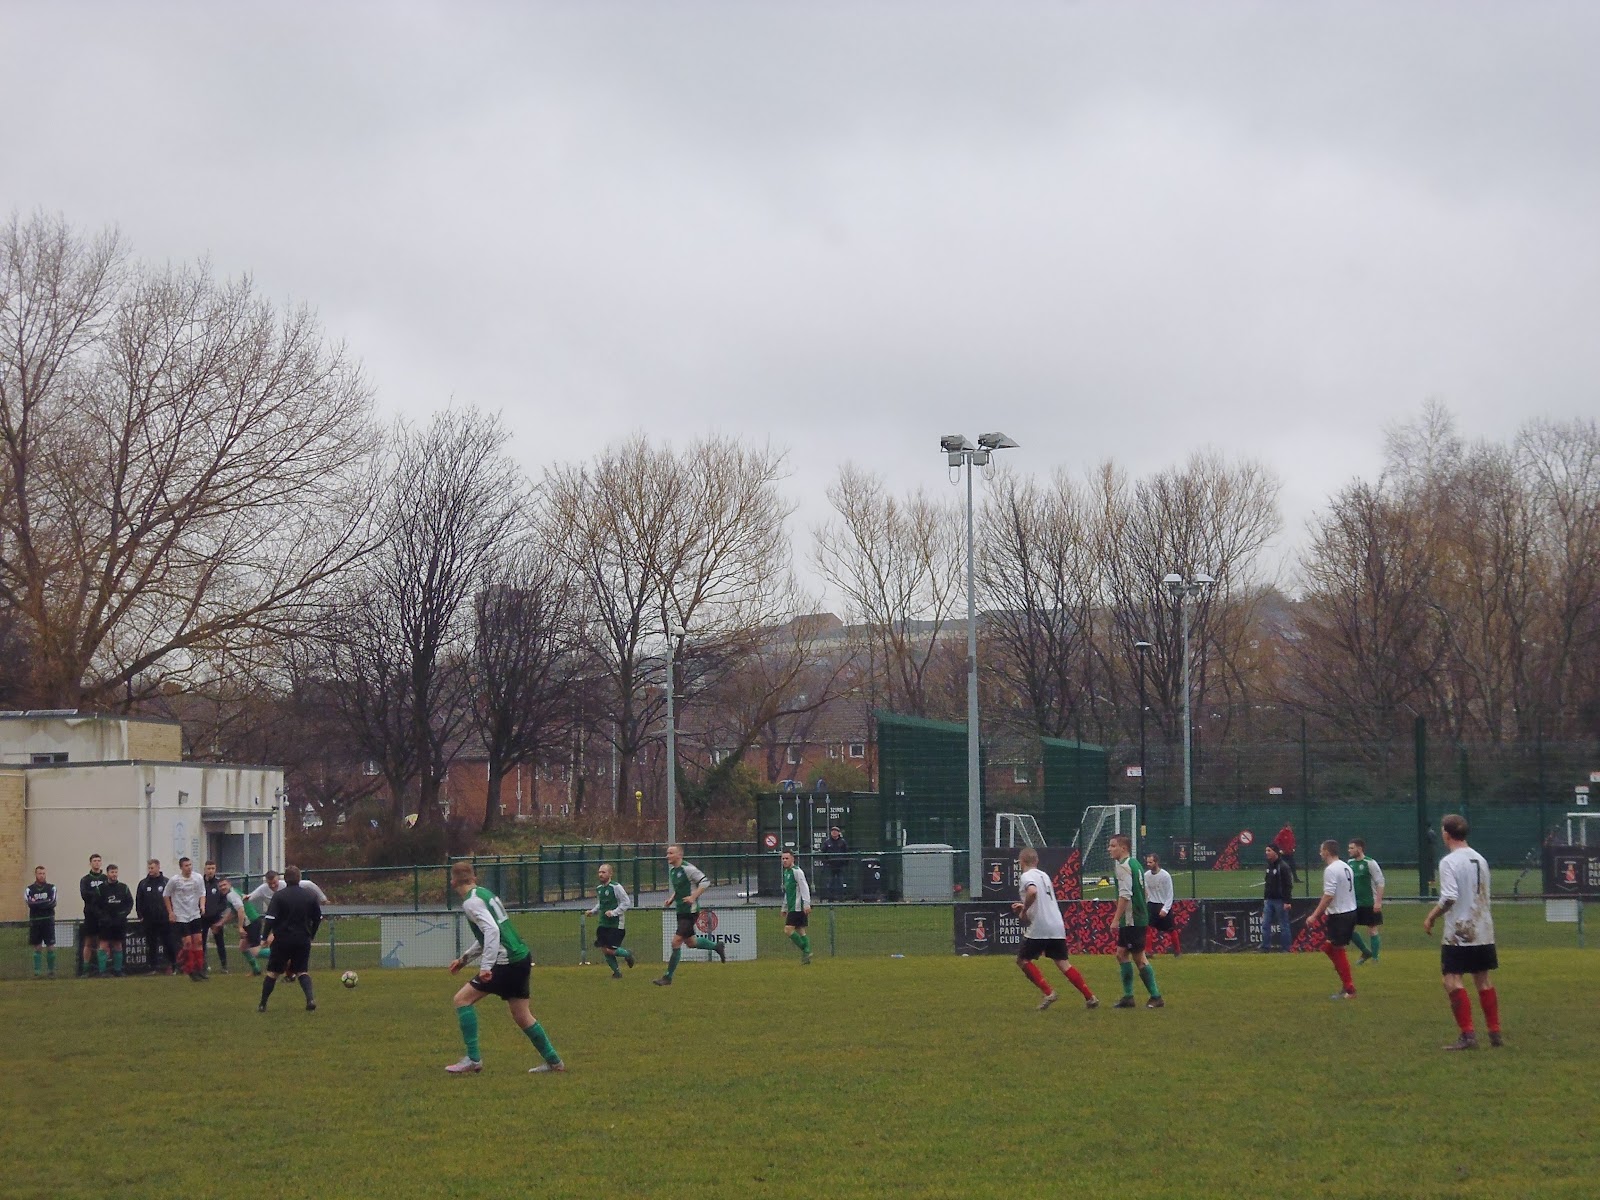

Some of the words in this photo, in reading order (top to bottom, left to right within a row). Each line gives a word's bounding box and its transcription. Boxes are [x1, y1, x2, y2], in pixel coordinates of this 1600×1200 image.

[1344, 867, 1352, 892] 9
[1469, 859, 1481, 894] 7
[999, 918, 1020, 926] NIKE
[125, 937, 147, 946] NIKE
[999, 936, 1020, 944] CLUB
[125, 946, 164, 955] PARTR
[125, 955, 147, 964] CLUB
